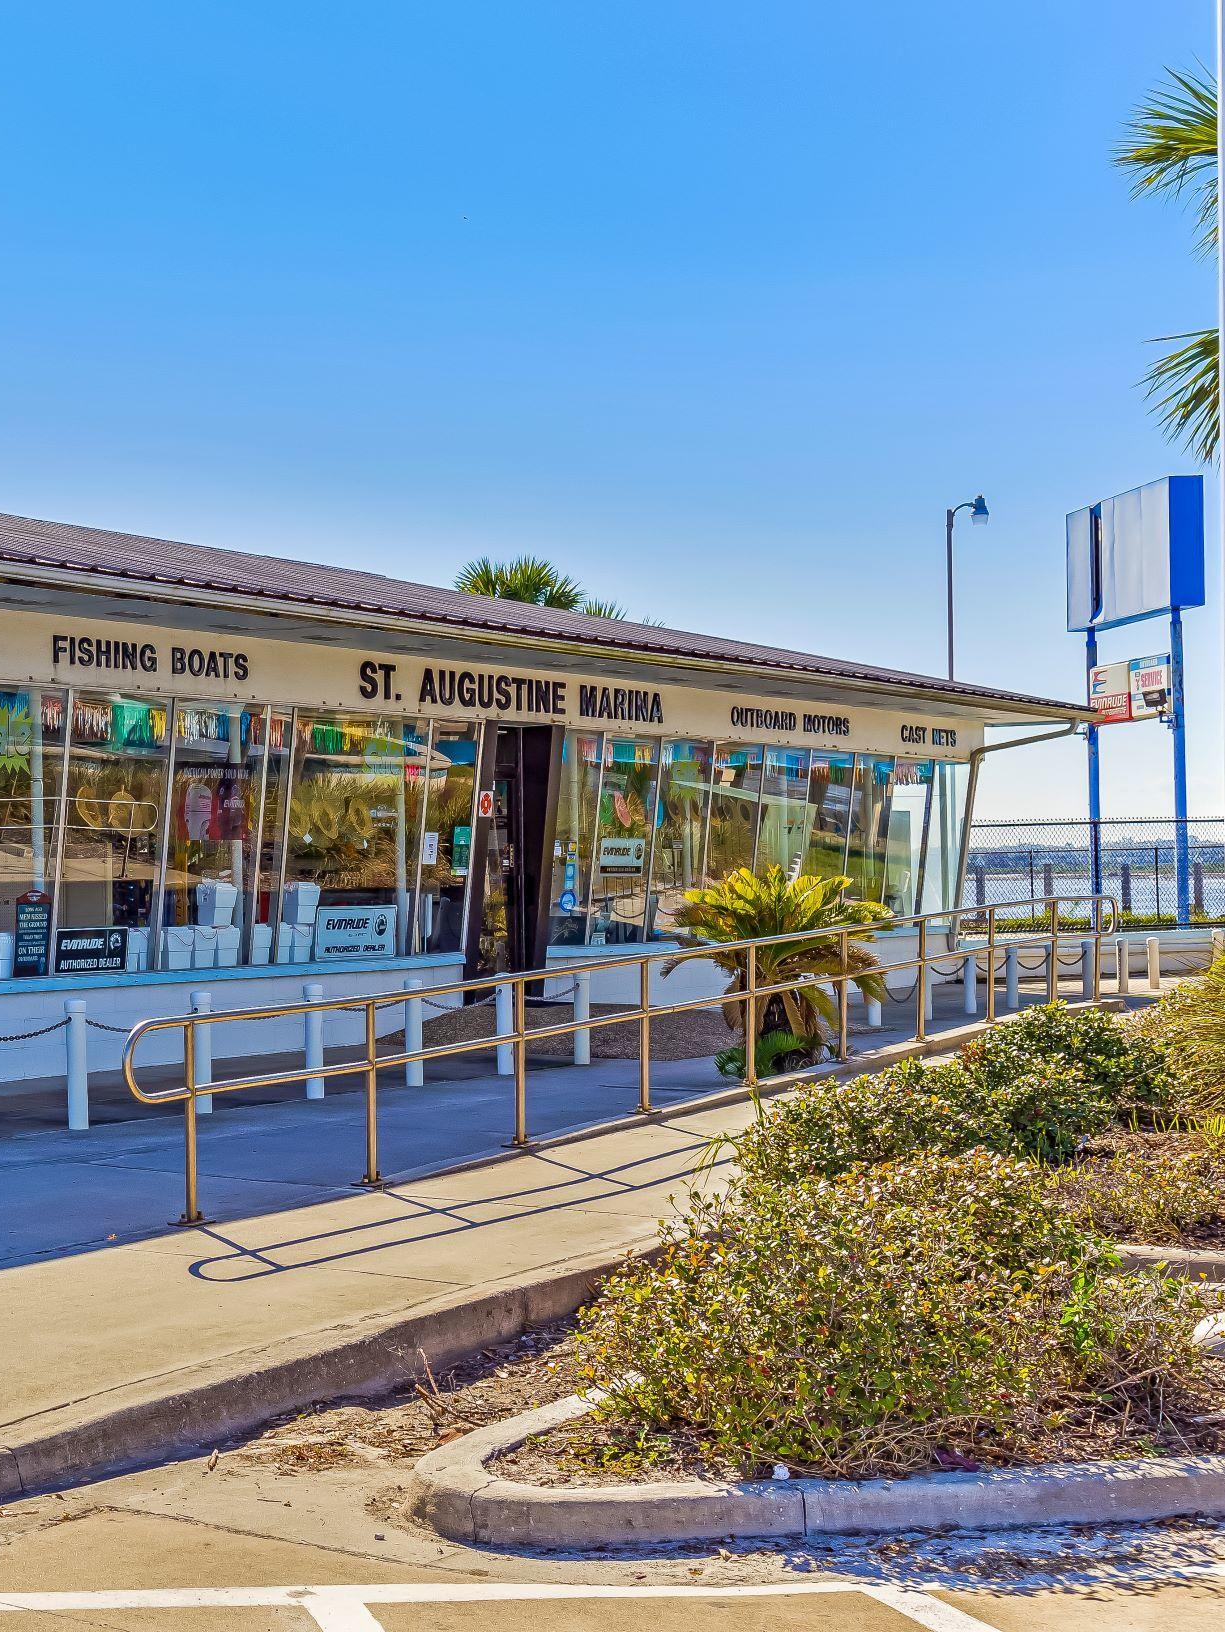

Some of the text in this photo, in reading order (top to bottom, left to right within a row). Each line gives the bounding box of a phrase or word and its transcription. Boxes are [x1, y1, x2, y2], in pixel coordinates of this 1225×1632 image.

[52, 634, 249, 681] FISHING BOATS
[1141, 670, 1163, 688] SERVICE
[359, 660, 664, 724] ST. AUGUSTINE MARINA
[730, 706, 850, 737] OUTBOARD MOTORS
[900, 724, 957, 748] CAST NETS
[602, 847, 631, 856] EVINRUDE
[326, 918, 370, 931] EVINRUDE
[27, 946, 45, 955] THEIR
[323, 944, 386, 954] AUTHORIZED DEALER
[59, 957, 121, 970] AUTHORIZED DEALER
